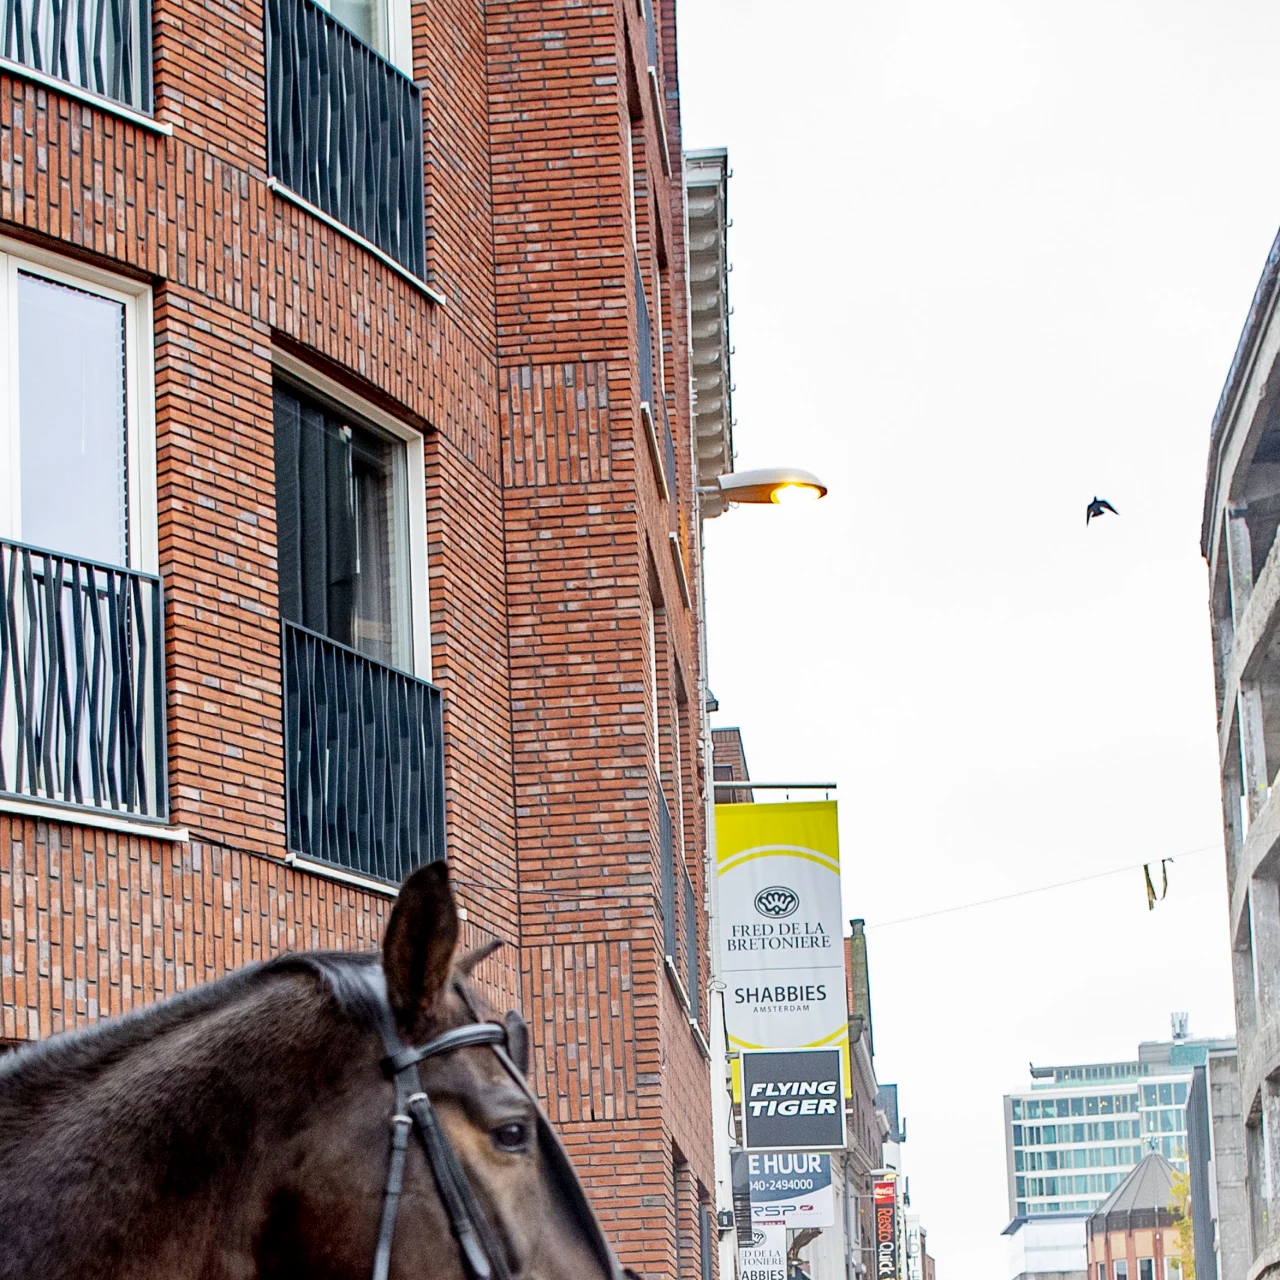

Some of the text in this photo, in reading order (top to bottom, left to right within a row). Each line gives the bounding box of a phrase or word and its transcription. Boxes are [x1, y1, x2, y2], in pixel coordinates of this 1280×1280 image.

[732, 922, 825, 937] FRED DE LA
[727, 935, 832, 951] BRETONIERE
[735, 984, 827, 1004] SHABBIES
[753, 1004, 810, 1013] AMSTERDAM
[750, 1080, 837, 1097] FLYING
[748, 1098, 838, 1117] TIGER
[748, 1152, 822, 1175] E HUUR
[909, 1229, 920, 1280] HOTE
[741, 1269, 785, 1280] ABBIES
